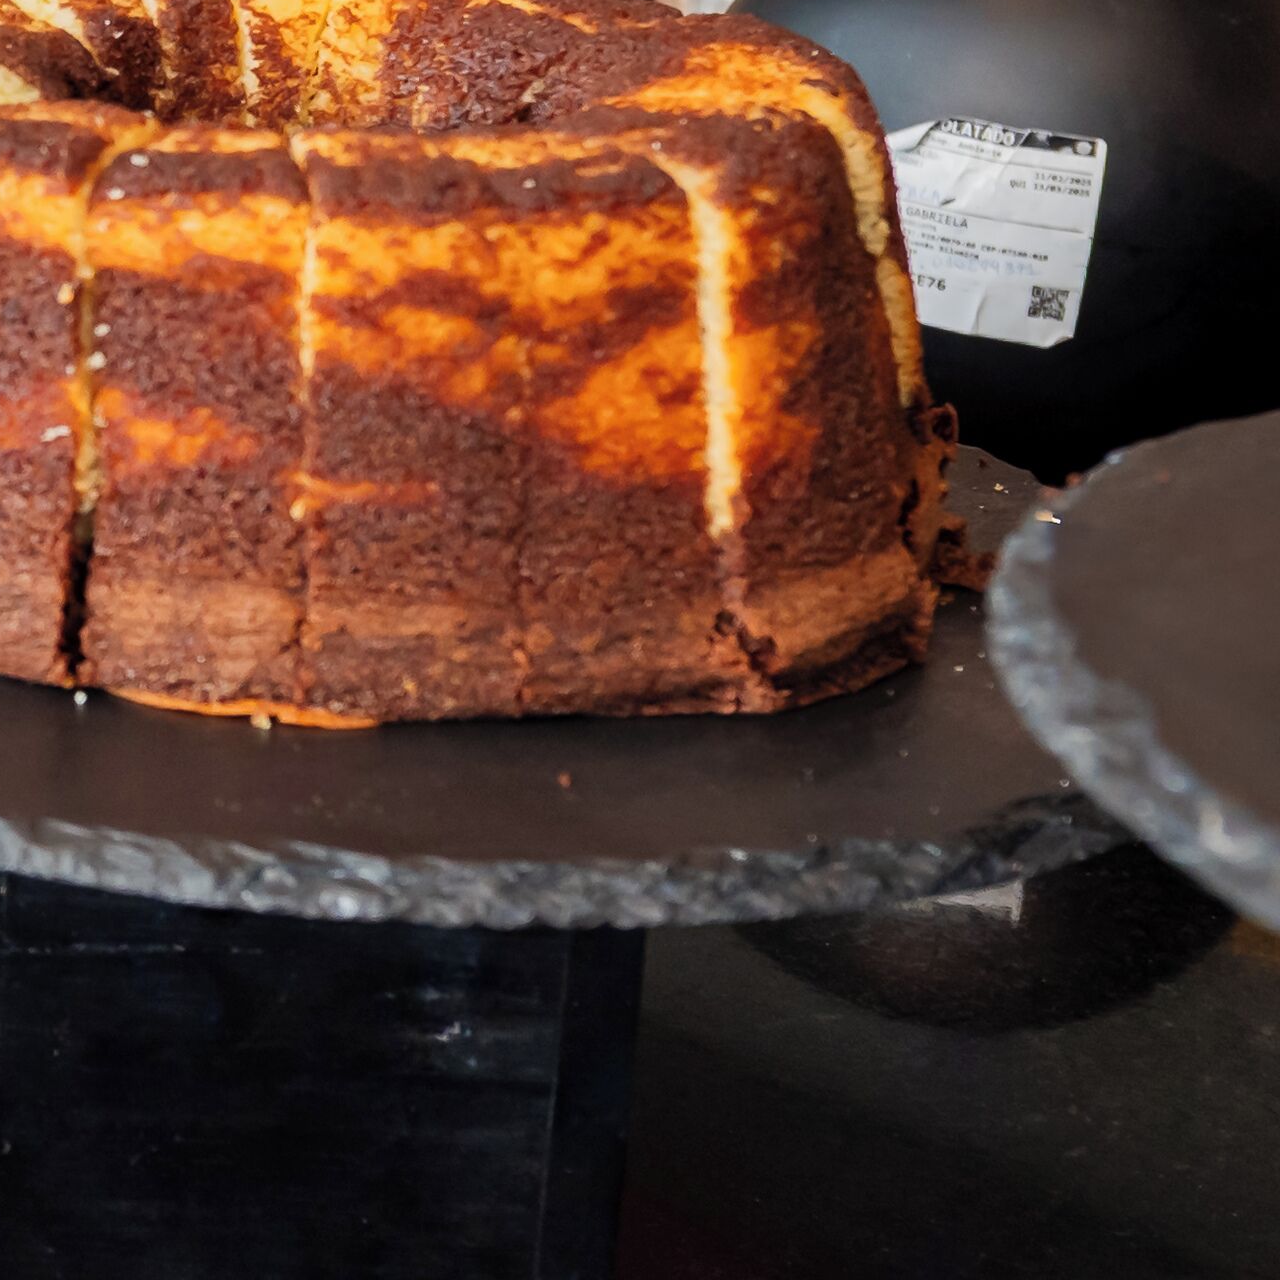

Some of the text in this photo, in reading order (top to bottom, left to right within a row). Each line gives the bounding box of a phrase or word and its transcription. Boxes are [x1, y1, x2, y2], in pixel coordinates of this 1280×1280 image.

[939, 119, 1016, 146] OLATADO
[905, 206, 969, 229] GABRIELA
[913, 273, 947, 291] E76
